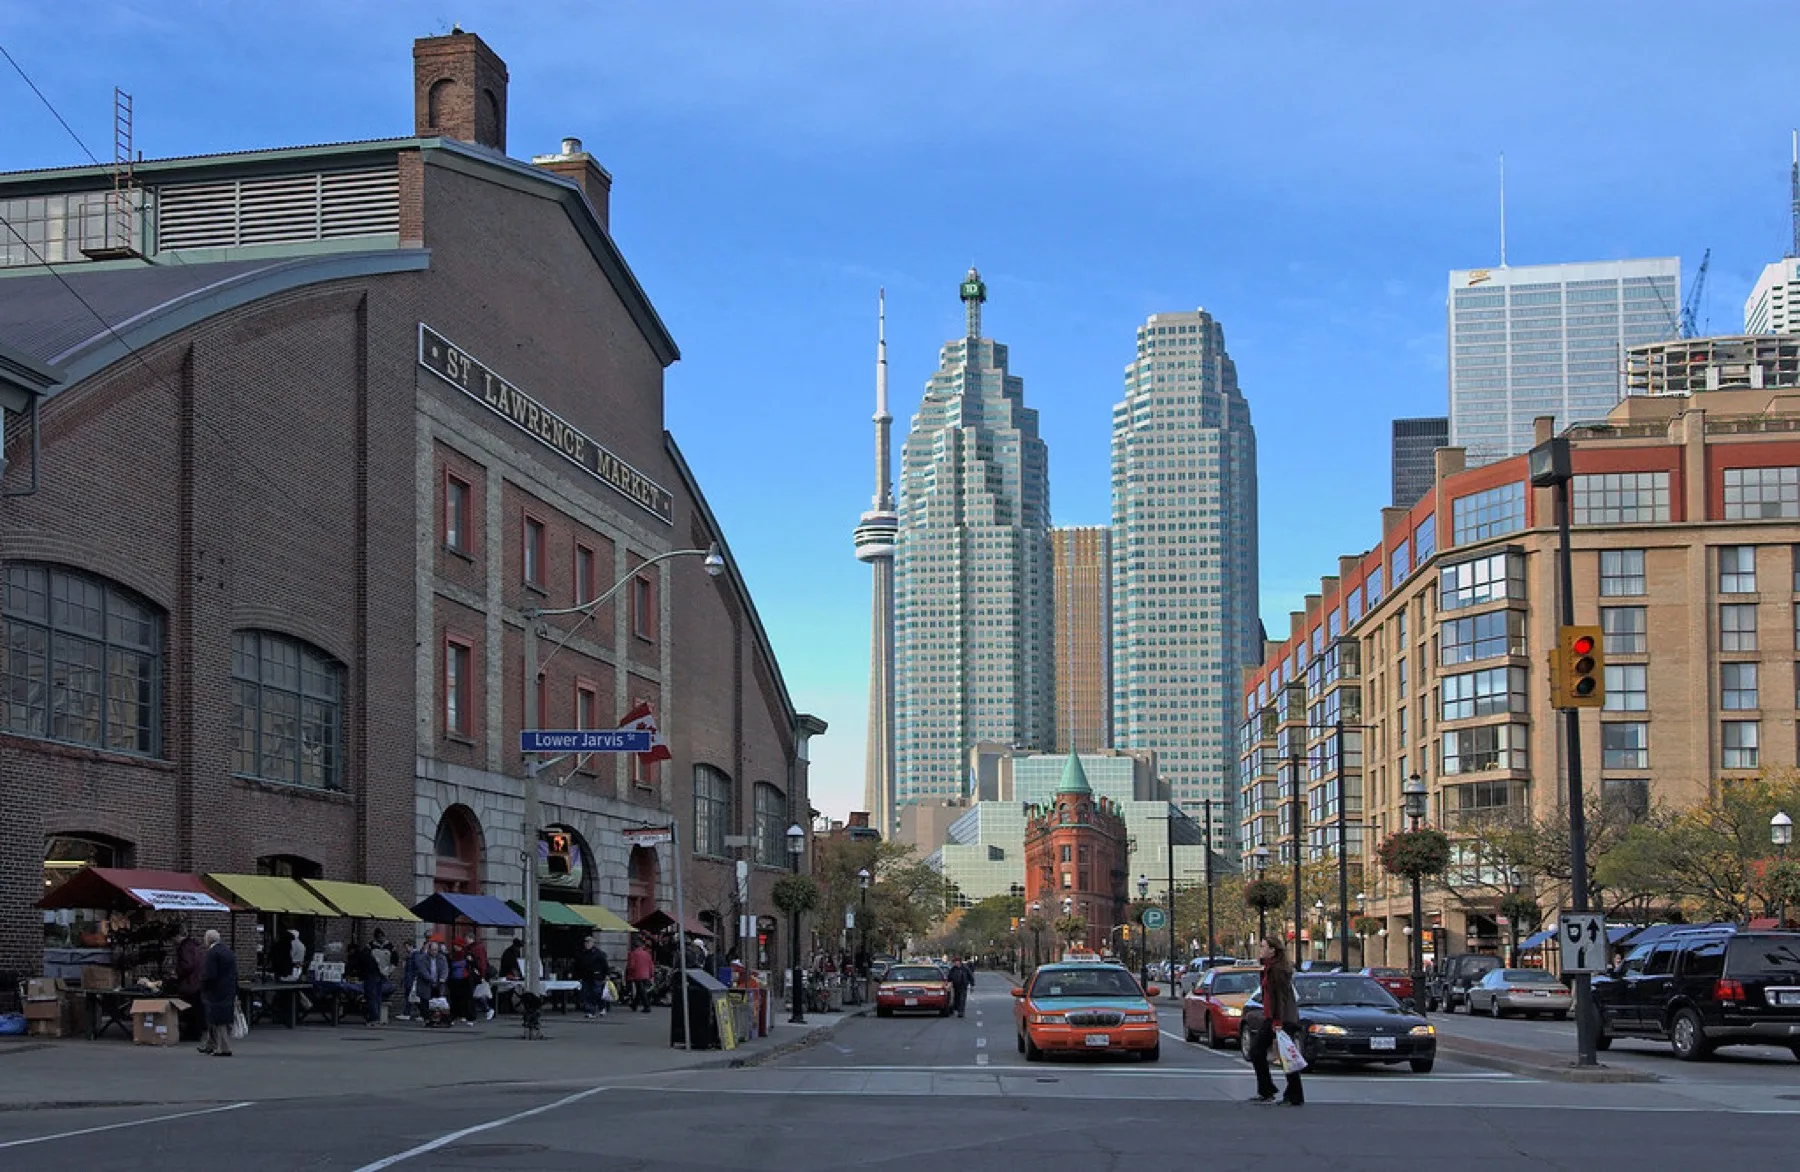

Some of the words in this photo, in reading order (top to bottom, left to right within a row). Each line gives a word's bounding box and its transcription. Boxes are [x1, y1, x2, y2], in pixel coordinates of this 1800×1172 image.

[964, 284, 978, 293] TD
[484, 373, 586, 463] LAWRENCE
[597, 450, 660, 509] MARKET
[535, 733, 578, 747] Lower
[581, 733, 624, 747] Jarvis
[1148, 911, 1161, 924] P
